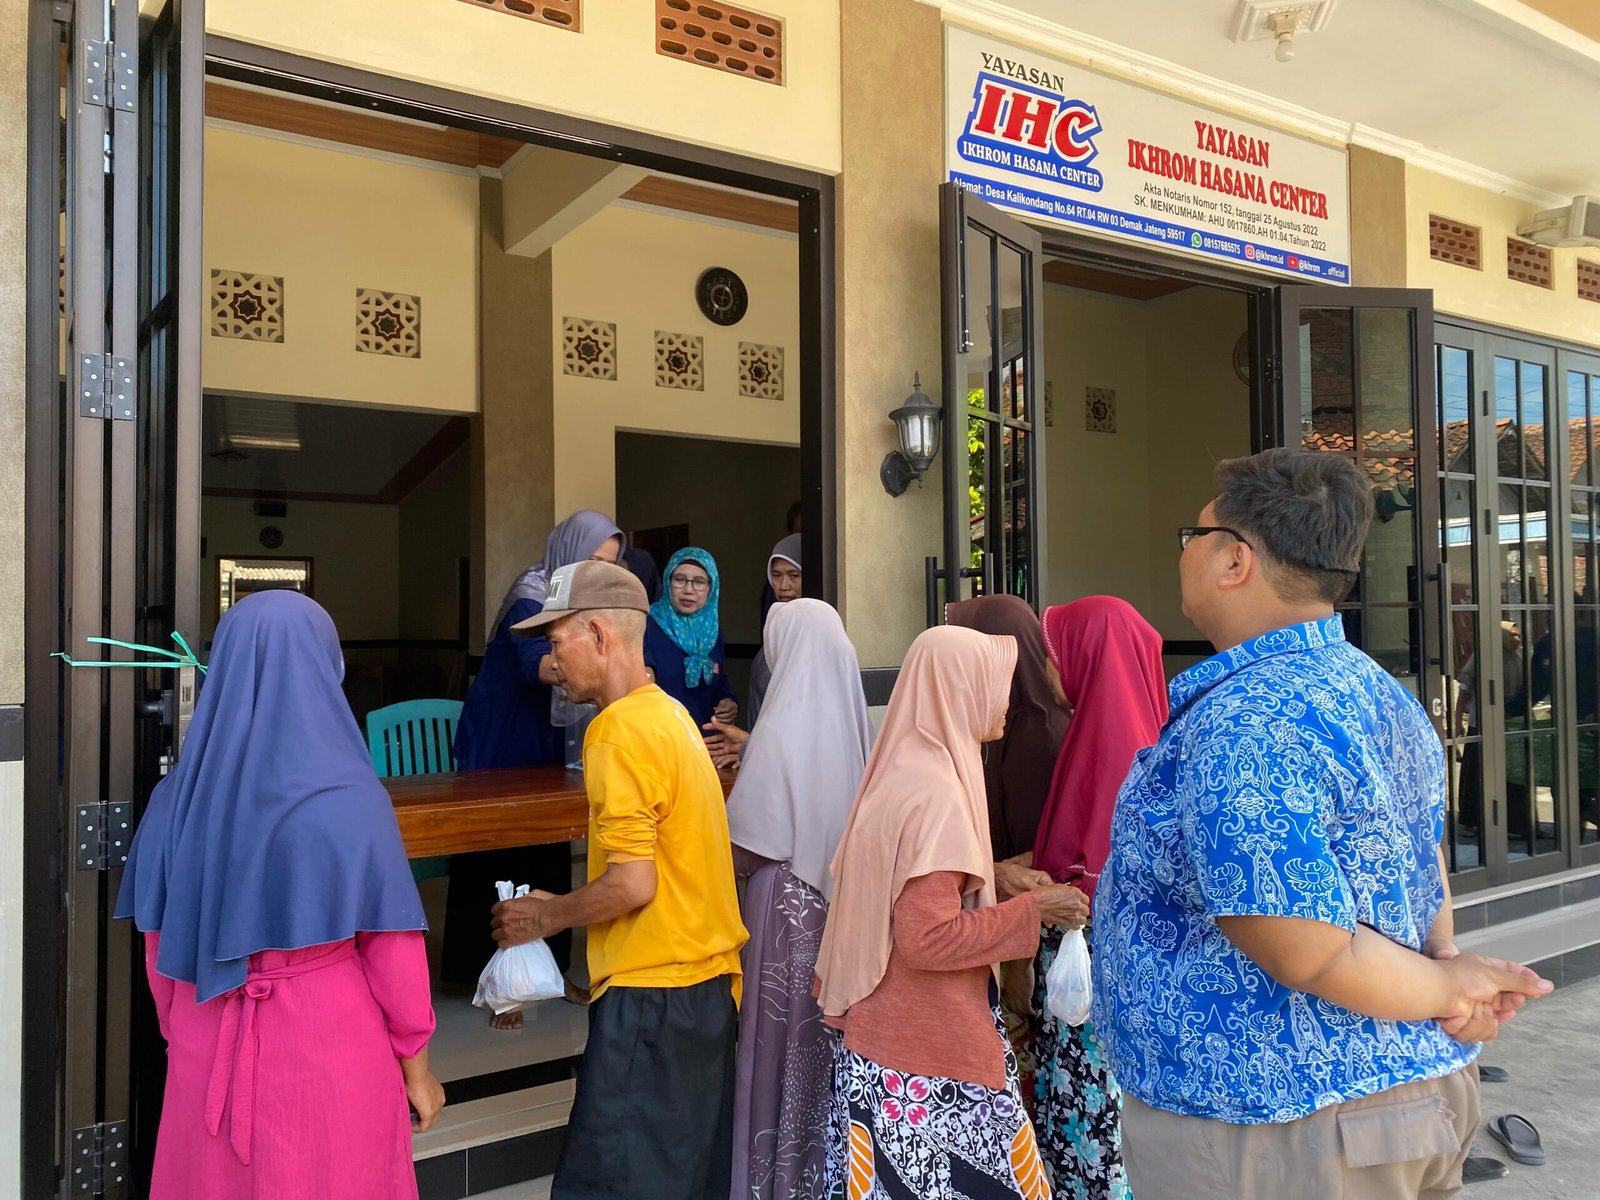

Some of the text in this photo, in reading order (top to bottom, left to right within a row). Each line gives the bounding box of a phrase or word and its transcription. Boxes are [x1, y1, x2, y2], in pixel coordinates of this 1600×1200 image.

[980, 51, 1064, 92] YAYASAN
[974, 84, 1094, 157] IHC
[1194, 120, 1270, 168] YAYASAN
[963, 140, 1100, 187] IKHROM HASANA CENTER
[1128, 139, 1328, 220] IKHROM HASANA CENTER
[986, 184, 1005, 200] Desa
[1007, 190, 1053, 213] Kalikondang
[1054, 201, 1075, 216] No.64
[1076, 206, 1096, 221] RT.04
[1097, 210, 1109, 223] RW
[1110, 213, 1119, 225] 03
[1120, 215, 1143, 231] Demak
[1144, 222, 1167, 240] Jateng
[1167, 228, 1186, 242] 59517
[1134, 195, 1148, 207] SK.
[1150, 198, 1207, 222] MENKUMHAM:
[1208, 212, 1225, 227] AHU
[1226, 218, 1268, 238] 0017860.AH
[1311, 239, 1326, 251] 2022
[1144, 183, 1318, 236] Akta Notaris Nomor 152, tanggal 25 Agustus 2022
